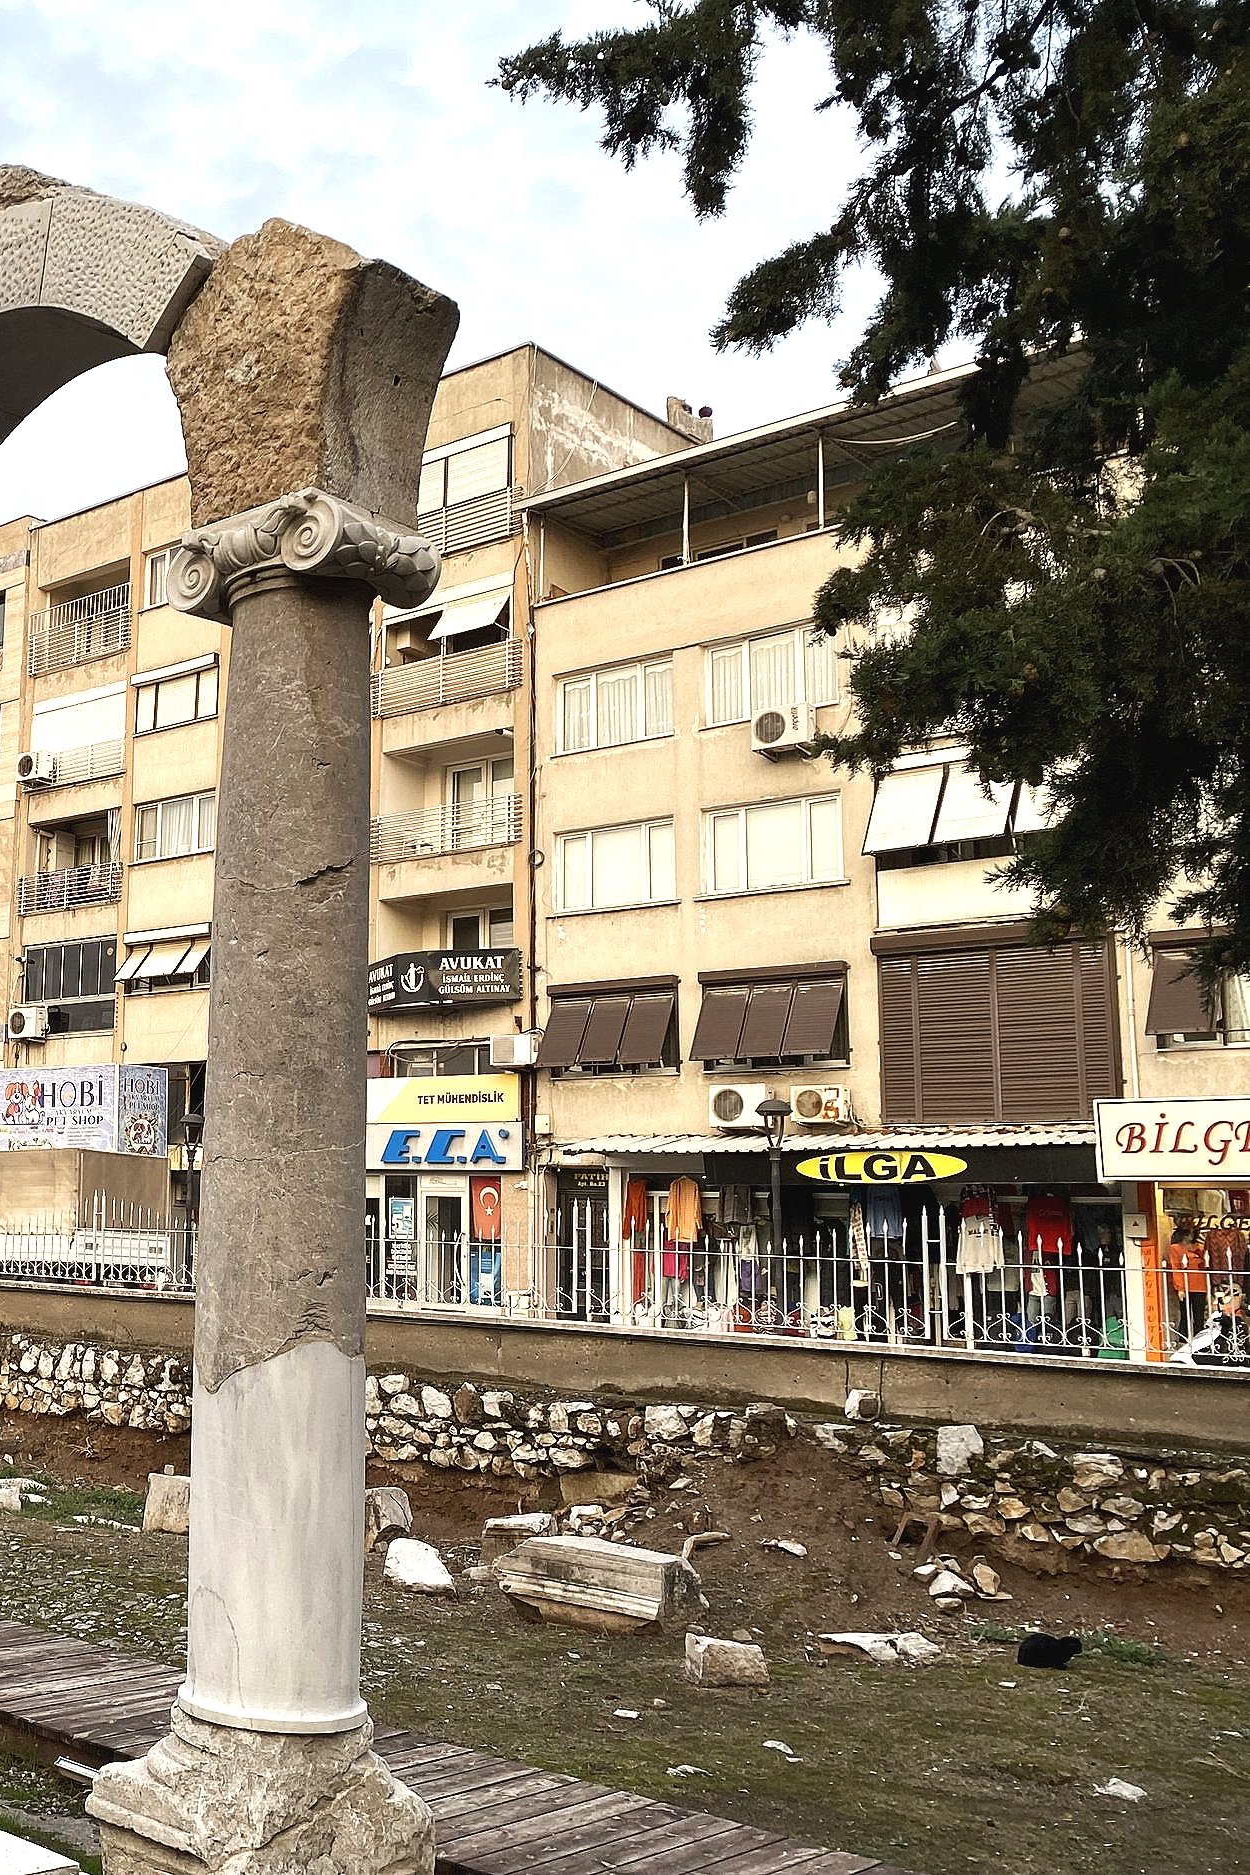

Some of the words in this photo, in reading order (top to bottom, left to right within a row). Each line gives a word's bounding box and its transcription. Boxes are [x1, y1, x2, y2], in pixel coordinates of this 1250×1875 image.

[439, 955, 505, 971] AVUKAT
[442, 973, 472, 984] İSMAİL
[473, 972, 506, 984] ERDİNÇ
[438, 984, 474, 995] GÜLSÜM
[476, 984, 511, 994] ALTINAY
[418, 1095, 435, 1105] TET
[437, 1091, 504, 1104] MÜHENDİSLİK
[46, 1116, 66, 1126] PET
[72, 1115, 104, 1126] SHOP
